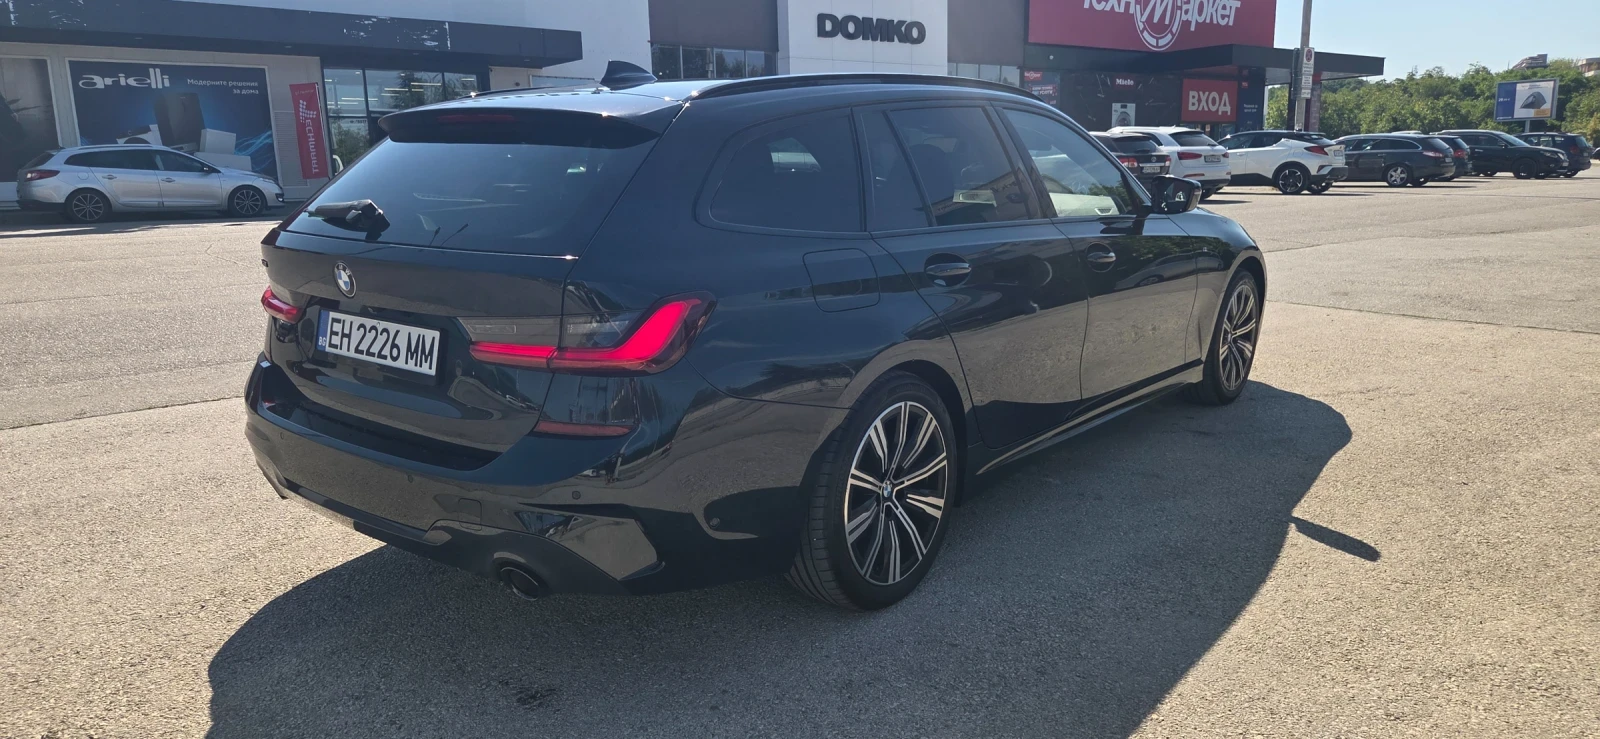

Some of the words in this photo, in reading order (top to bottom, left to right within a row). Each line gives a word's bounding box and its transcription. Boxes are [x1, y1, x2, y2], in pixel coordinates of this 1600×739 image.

[817, 13, 926, 45] DOMKO
[79, 68, 170, 89] arielli
[187, 78, 227, 86] Модерните
[1188, 91, 1231, 115] ВХОД
[318, 336, 327, 346] BG
[328, 317, 353, 352] EH
[354, 323, 401, 362] 2226
[405, 332, 435, 370] MM
